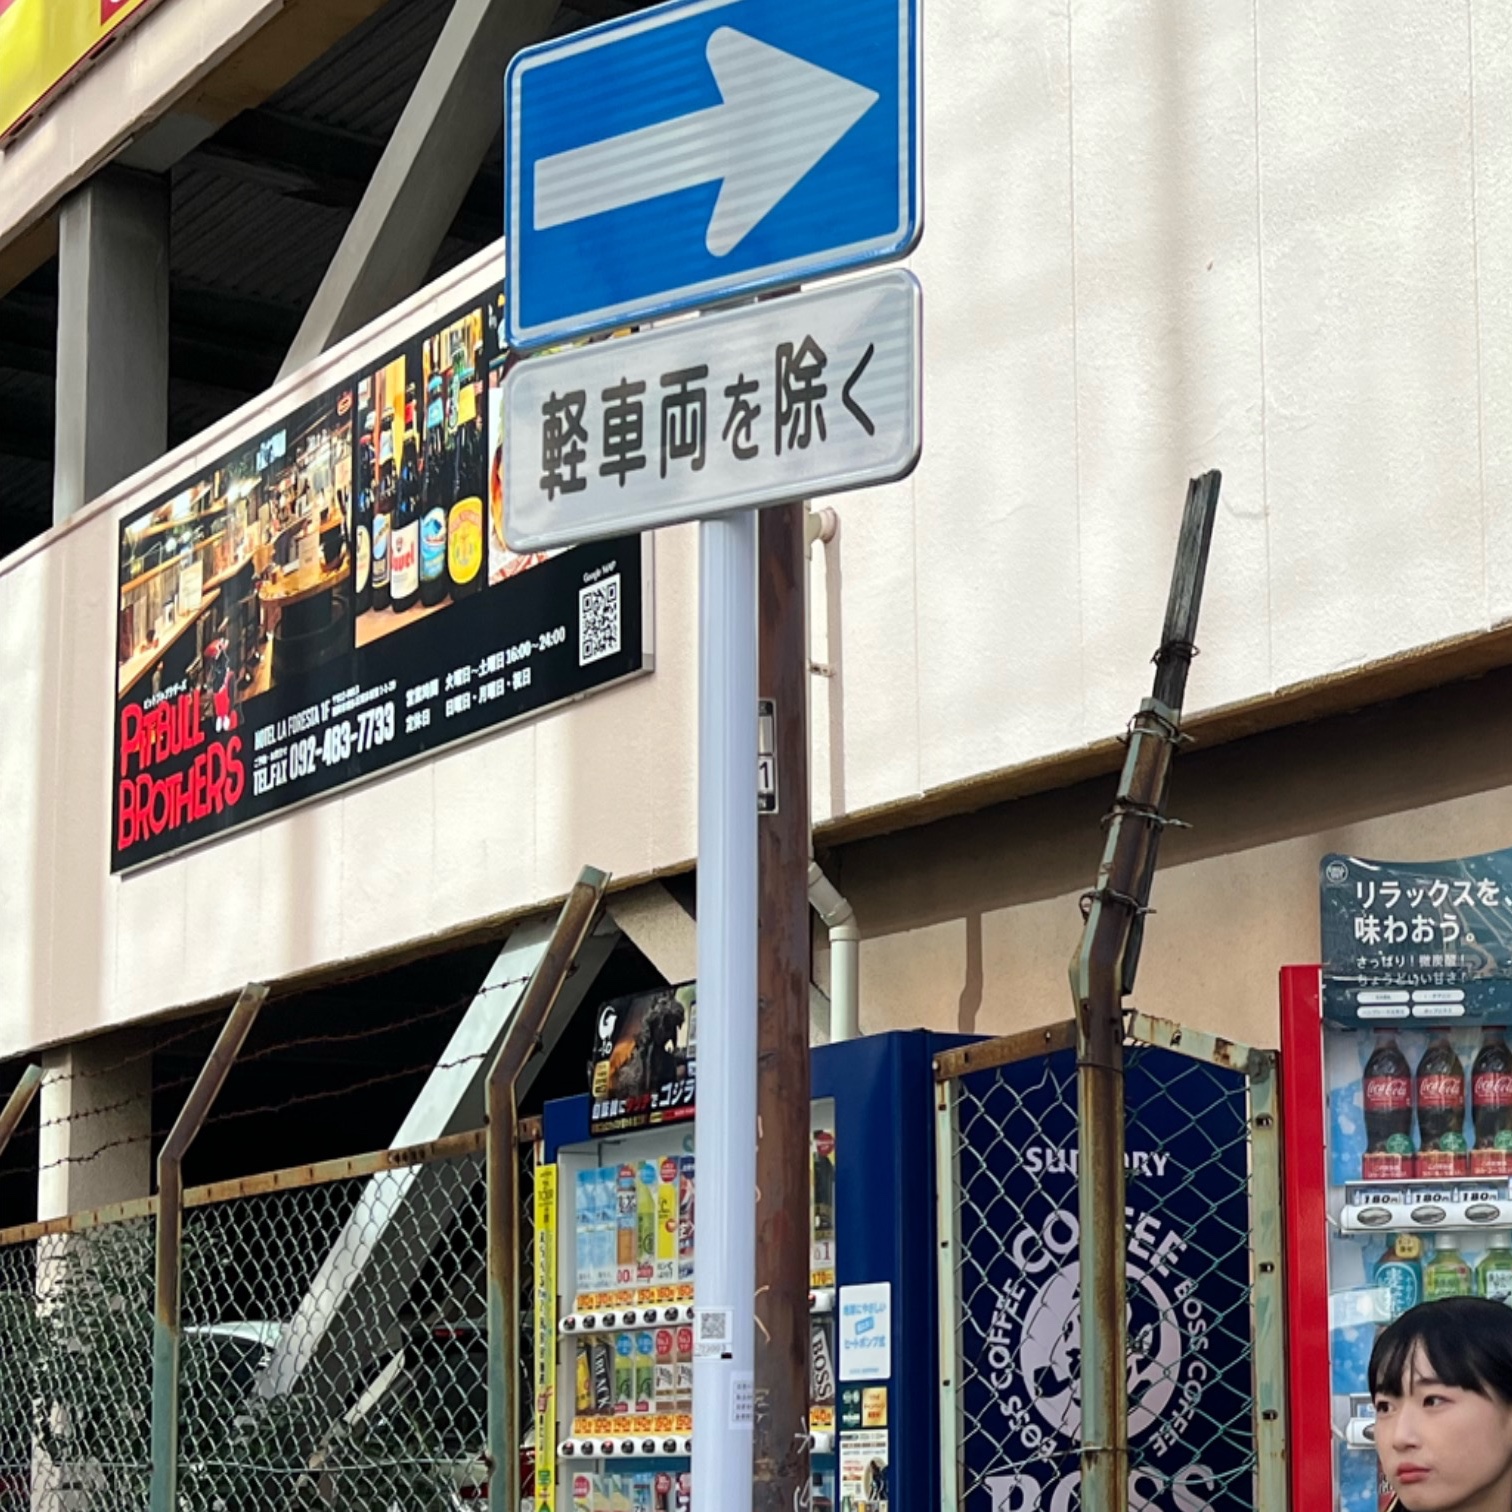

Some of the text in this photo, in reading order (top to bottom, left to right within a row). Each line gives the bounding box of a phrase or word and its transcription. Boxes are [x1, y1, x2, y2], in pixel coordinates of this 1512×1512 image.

[539, 334, 877, 500] 軽車両を除く
[120, 687, 205, 776] PITBULL
[277, 719, 287, 740] LA
[406, 708, 430, 733] 定休日
[253, 701, 395, 796] TEL.FAX 092-483-7733
[117, 735, 245, 850] BROTHERS
[1356, 878, 1512, 908] リラックスを、
[1354, 914, 1475, 945] 味わおう。
[1367, 1079, 1408, 1098] Coca-Cola
[1419, 1077, 1461, 1097] Coca-Cola
[1026, 1148, 1170, 1177] SURY
[1364, 1192, 1398, 1203] 180円
[1415, 1191, 1449, 1202] 180円
[1463, 1190, 1497, 1201] 180円
[1012, 1206, 1188, 1278] COEE
[988, 1278, 1026, 1389] COFFEE
[812, 1338, 833, 1398] BOSS
[1149, 1280, 1209, 1457] BOSS COFFEE
